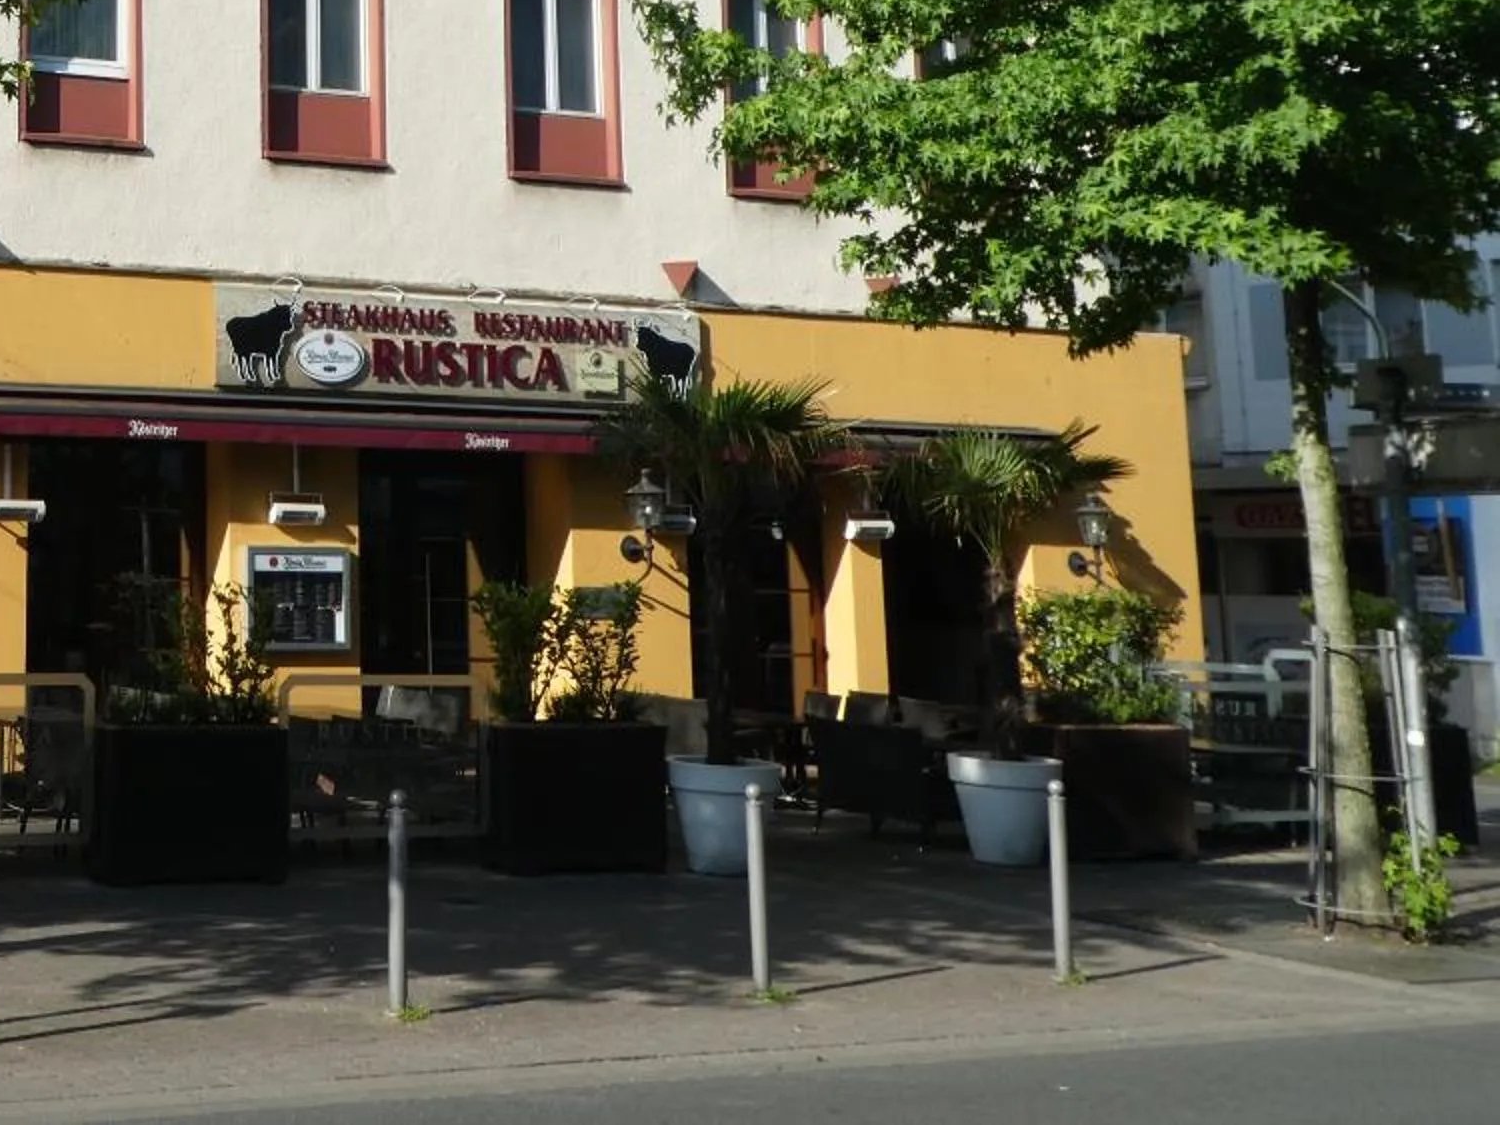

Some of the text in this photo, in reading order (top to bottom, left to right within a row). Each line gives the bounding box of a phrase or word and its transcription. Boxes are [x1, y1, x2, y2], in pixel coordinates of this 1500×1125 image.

[303, 300, 627, 345] STEAKHAUS RESTAURANT
[371, 338, 570, 392] RUSTICA
